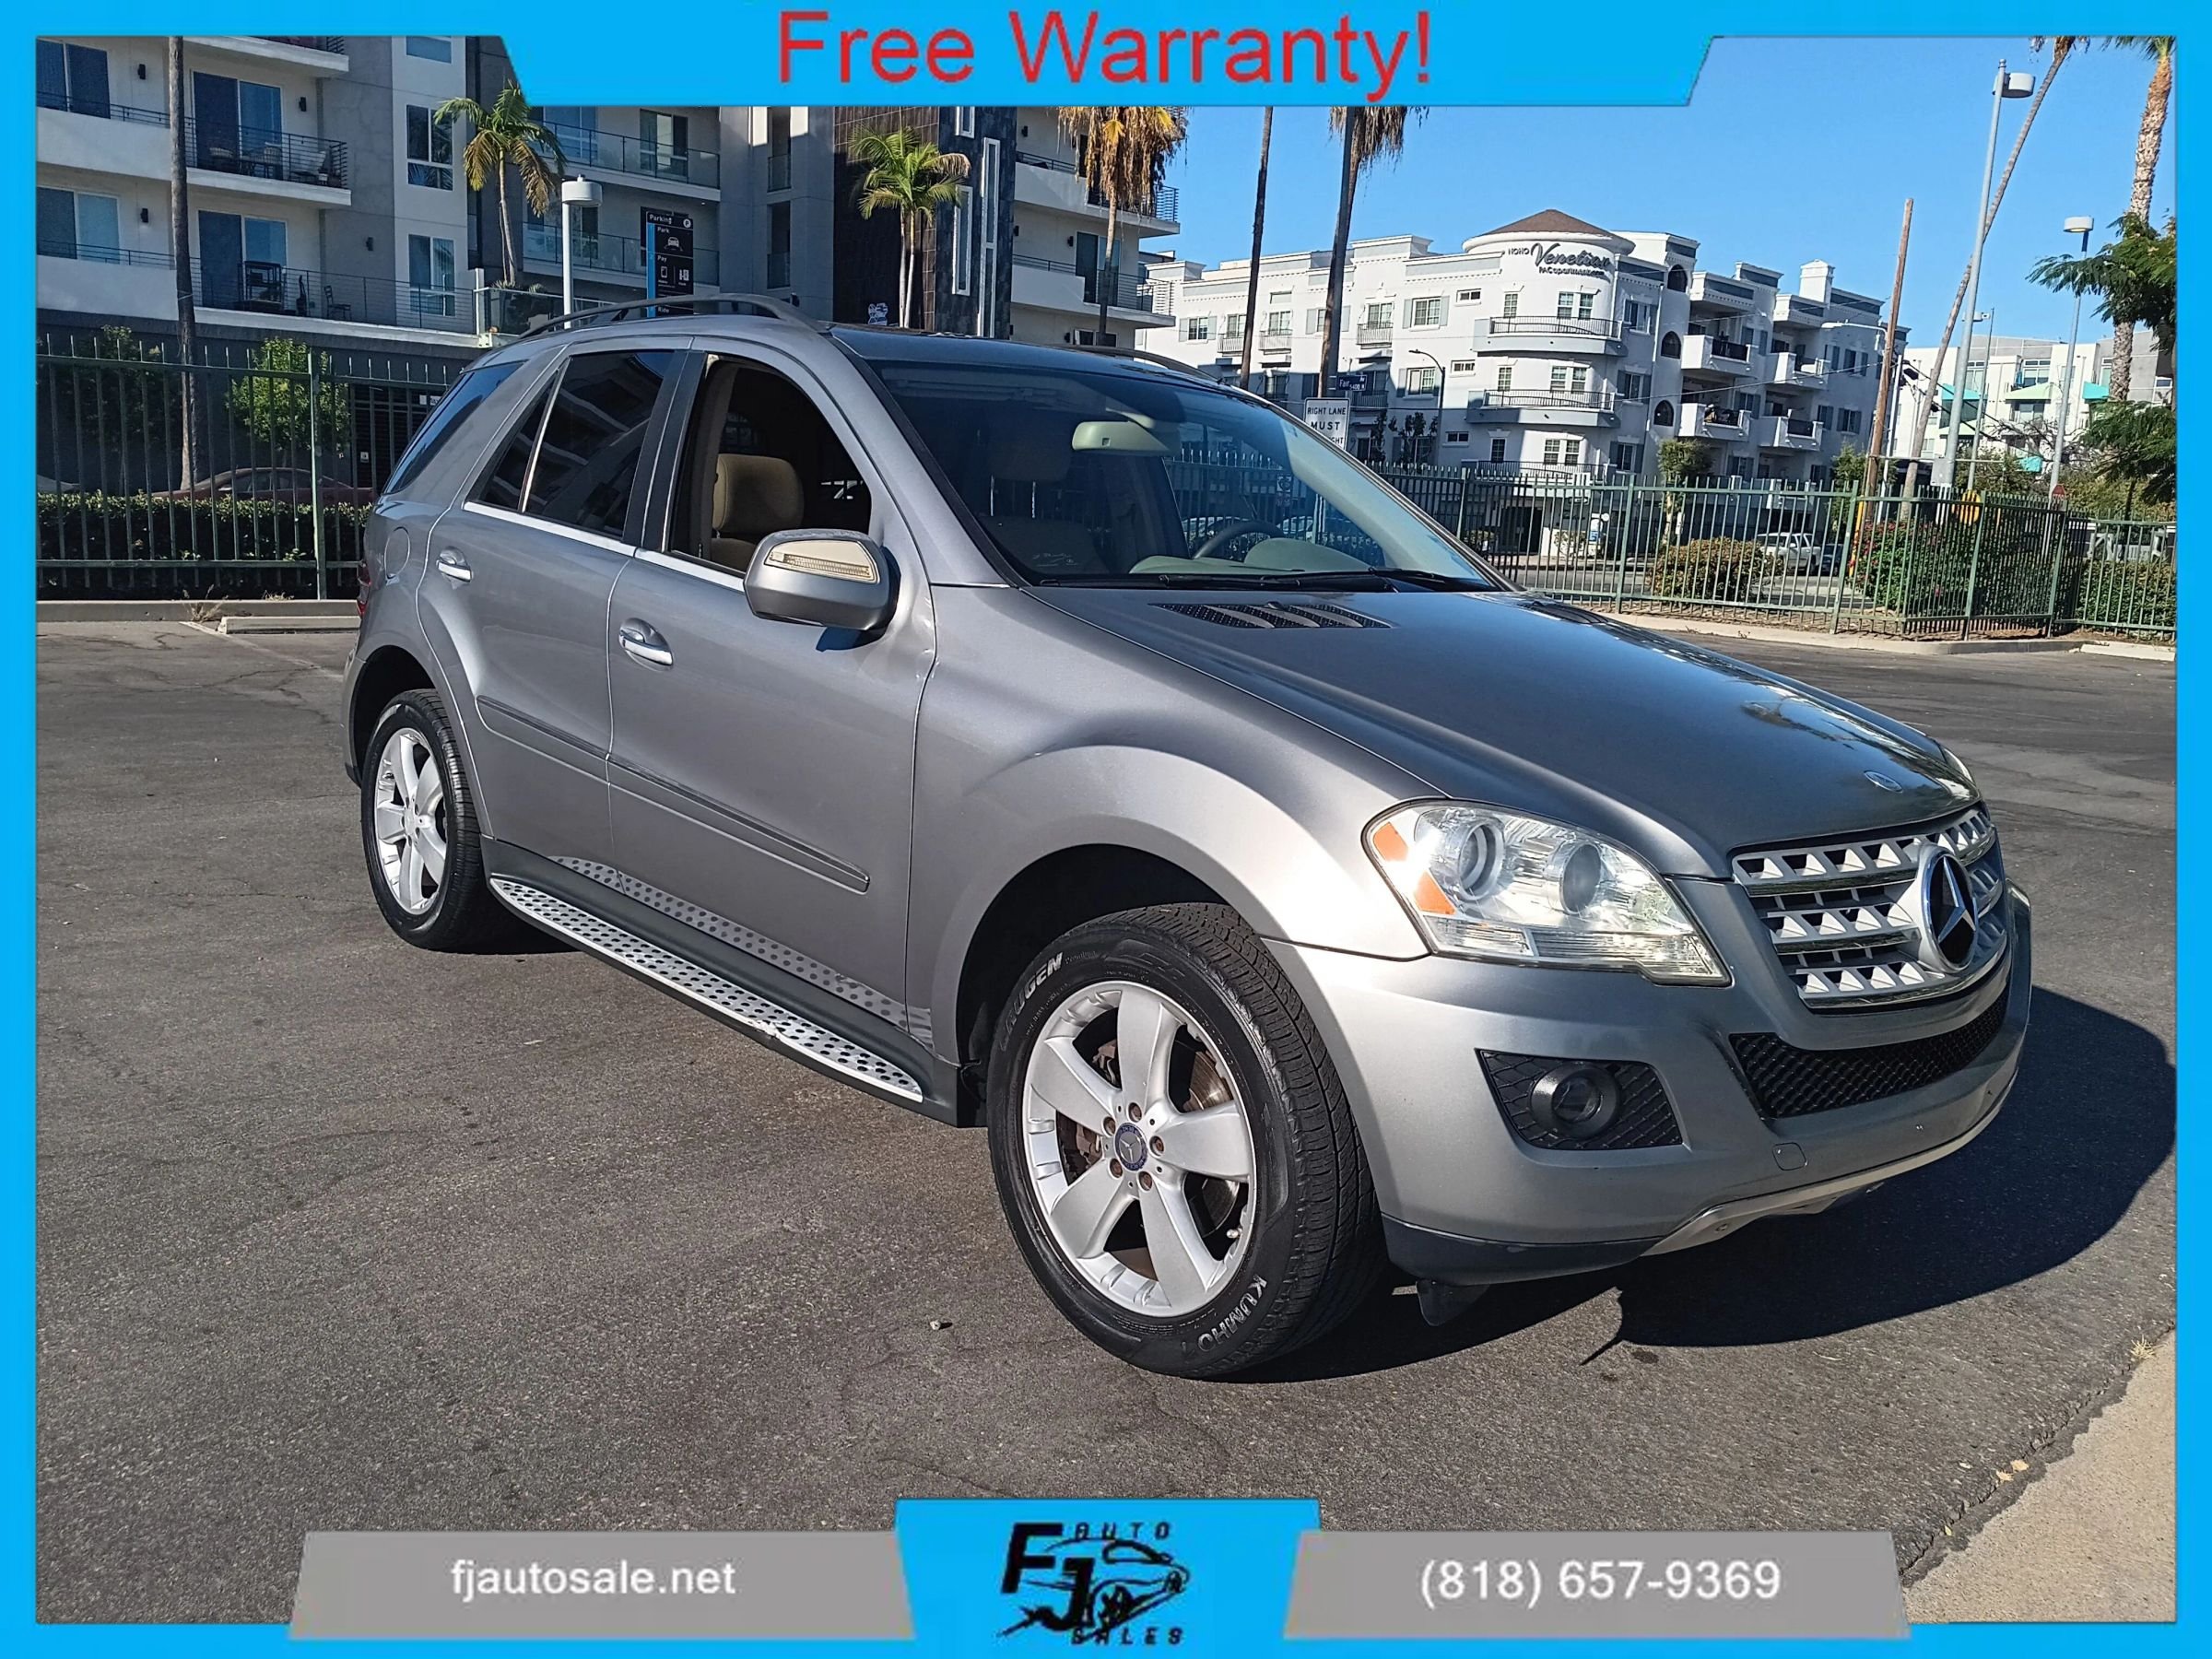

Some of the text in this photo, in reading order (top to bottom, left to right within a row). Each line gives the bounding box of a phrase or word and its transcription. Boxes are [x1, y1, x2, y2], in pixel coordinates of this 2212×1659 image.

[649, 214, 673, 224] Parking
[657, 254, 667, 263] Pay
[1530, 242, 1612, 268] Venetian
[1339, 379, 1350, 387] Fair
[1307, 406, 1347, 415] RIGHT LANE
[1310, 421, 1341, 430] MUST
[1197, 1273, 1267, 1352] KUMHO
